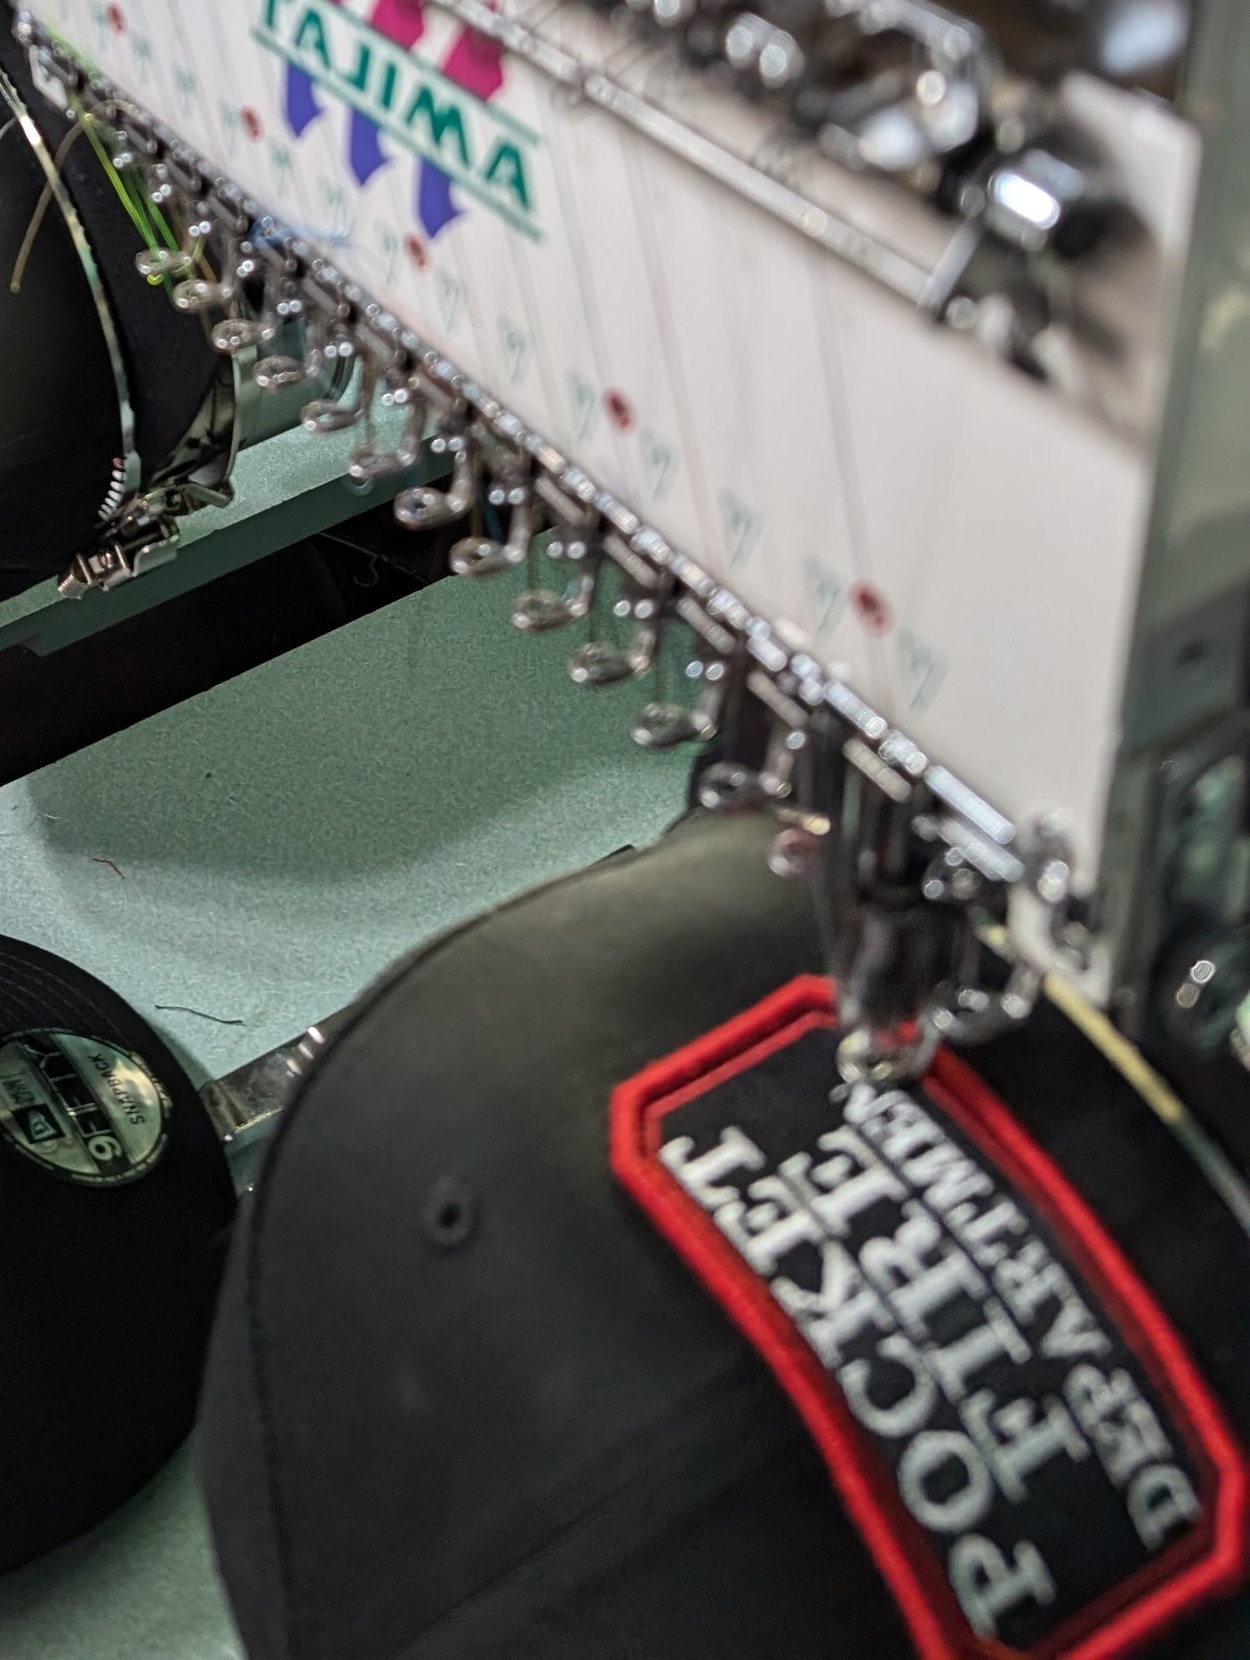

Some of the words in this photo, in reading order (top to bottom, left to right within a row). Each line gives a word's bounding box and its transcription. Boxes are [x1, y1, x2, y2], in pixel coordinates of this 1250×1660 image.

[88, 1054, 146, 1126] SNAPBACK
[659, 1125, 1057, 1640] POCKET
[779, 1124, 1090, 1504] FIRE
